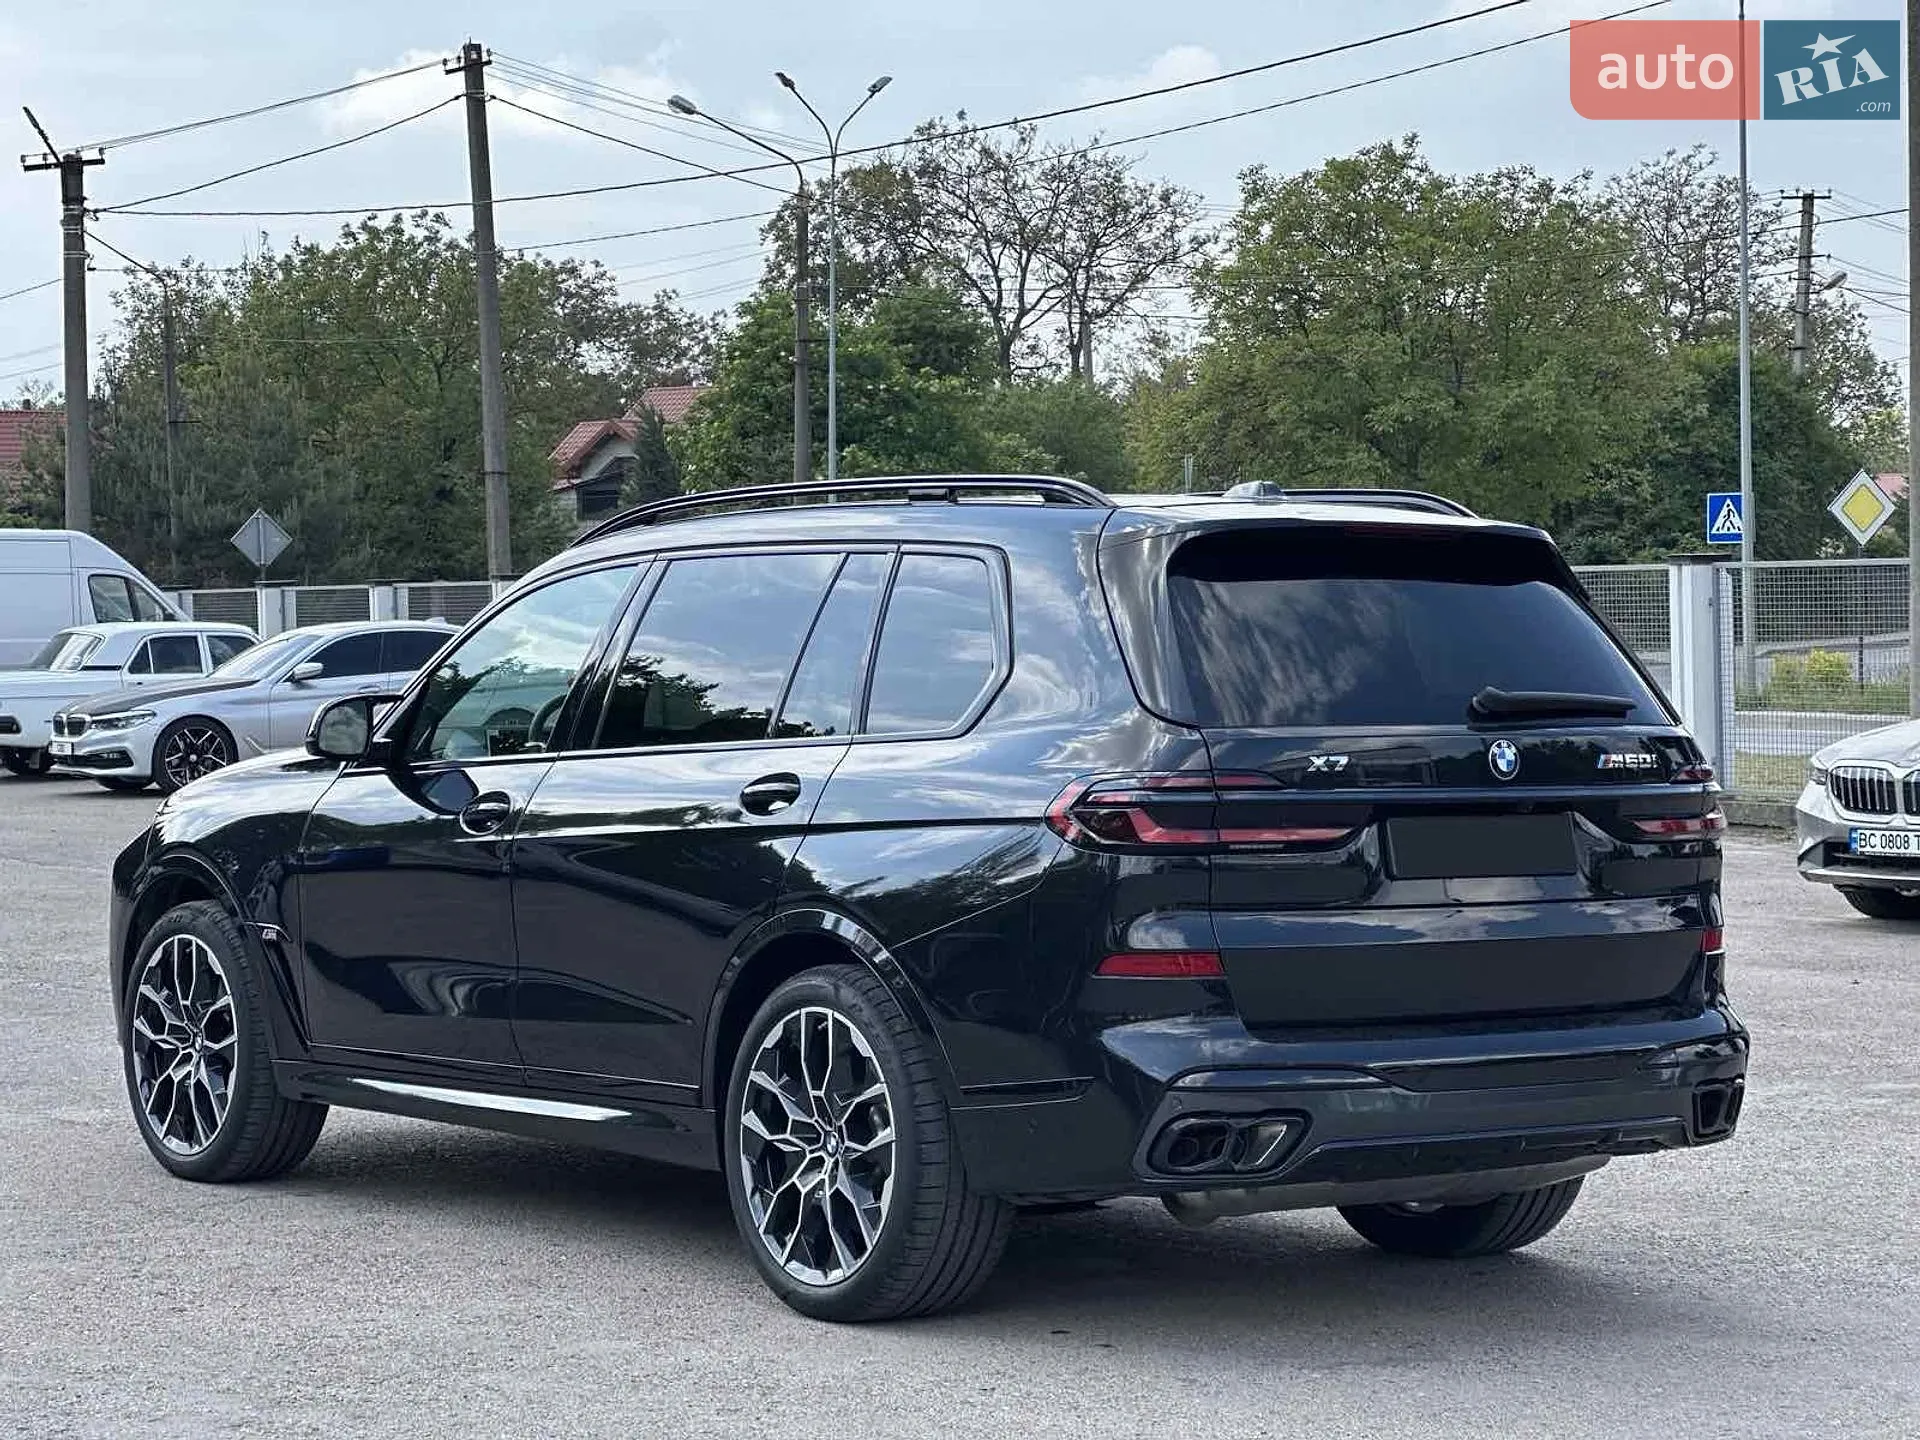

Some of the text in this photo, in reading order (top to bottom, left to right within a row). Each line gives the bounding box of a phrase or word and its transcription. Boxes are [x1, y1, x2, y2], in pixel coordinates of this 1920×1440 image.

[1307, 755, 1349, 771] X7
[1859, 832, 1877, 849] BC
[1880, 833, 1910, 850] 0808
